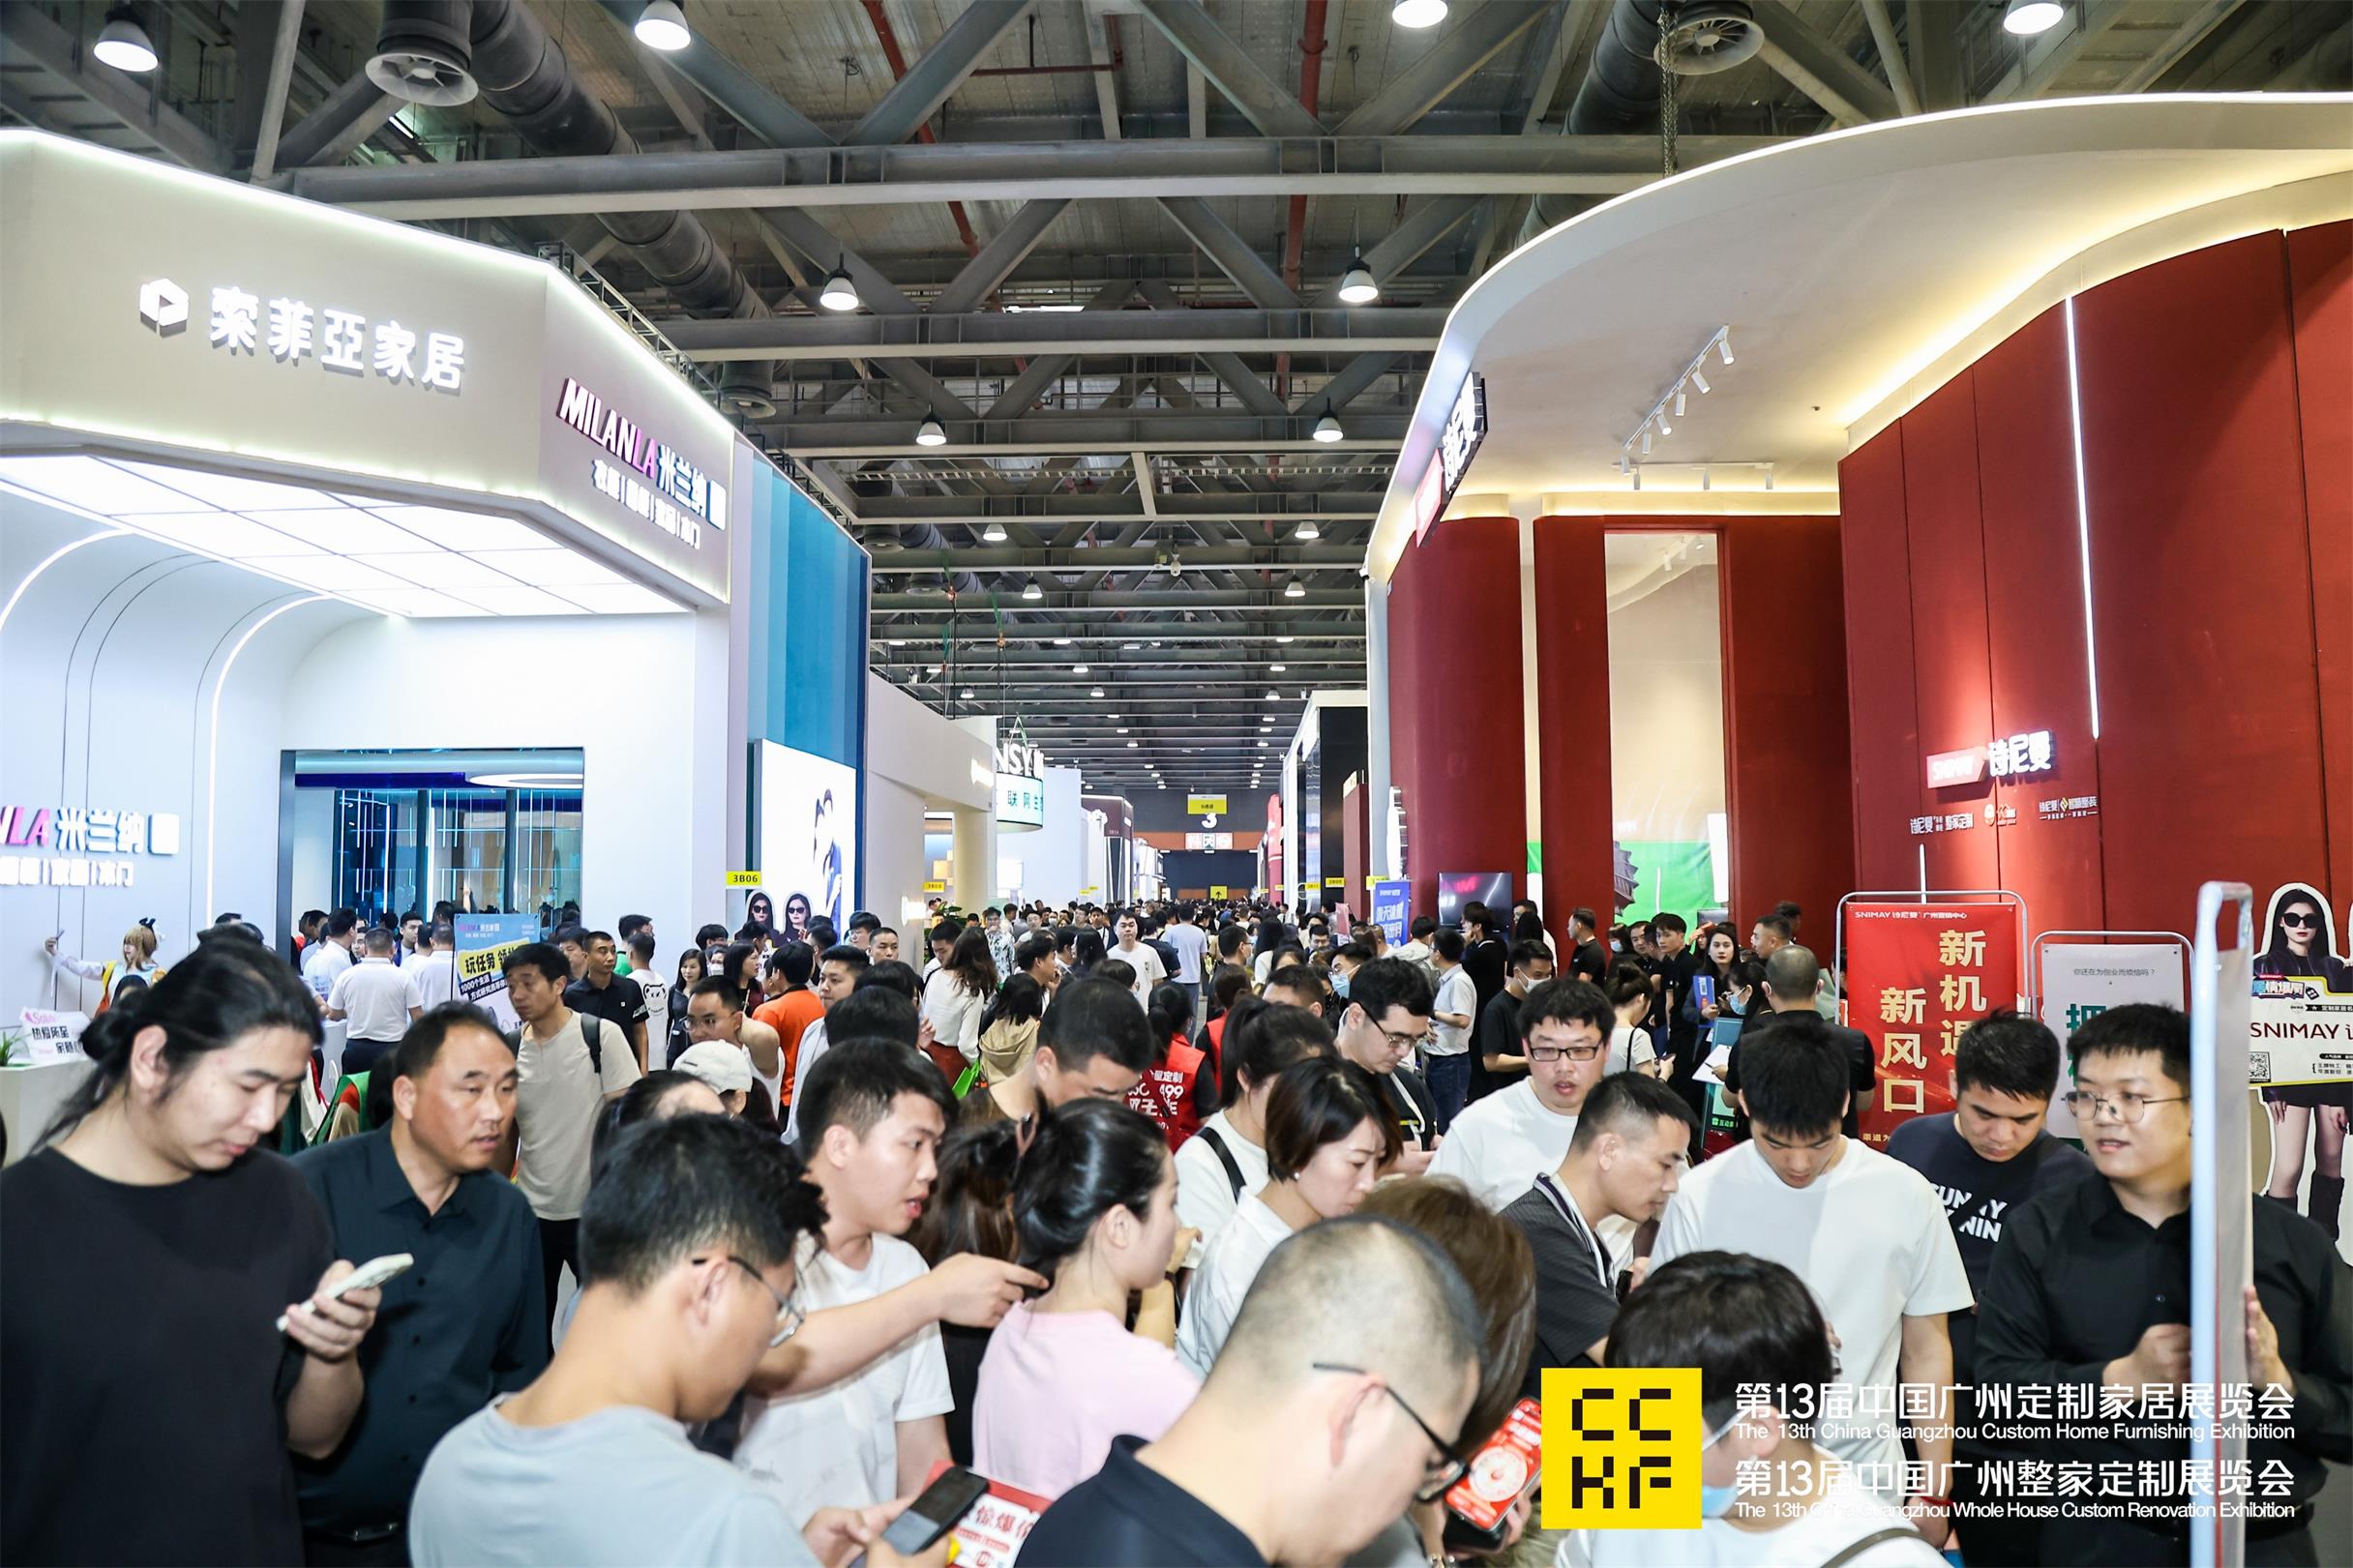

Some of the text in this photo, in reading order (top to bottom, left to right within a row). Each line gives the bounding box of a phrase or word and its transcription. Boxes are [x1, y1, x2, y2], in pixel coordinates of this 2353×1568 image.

[209, 286, 465, 391] 索菲亞家居
[658, 443, 707, 518] 米兰纳
[0, 805, 50, 846] LA
[1201, 812, 1218, 829] 3
[732, 873, 759, 884] 3B06
[464, 952, 495, 975] 玩任务
[2250, 1021, 2339, 1040] SNIMAY
[1880, 987, 1928, 1114] 新风口
